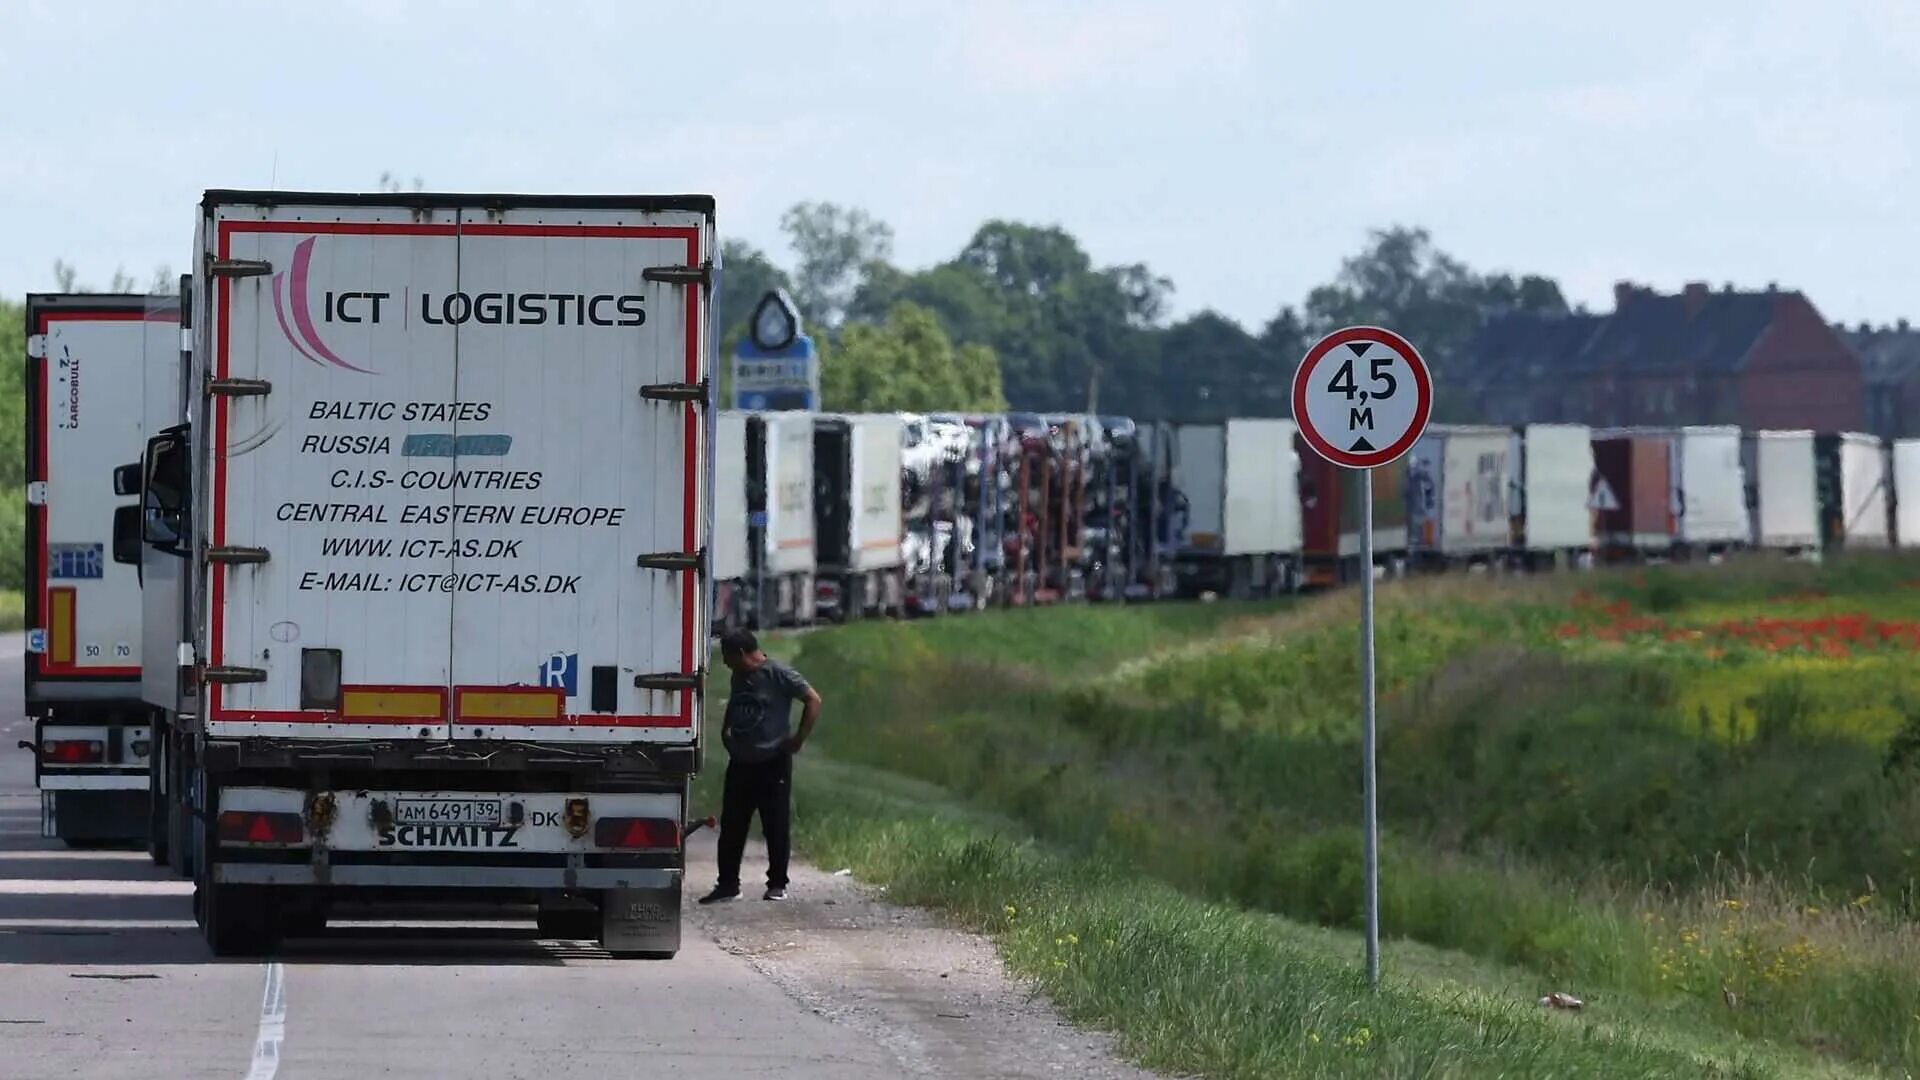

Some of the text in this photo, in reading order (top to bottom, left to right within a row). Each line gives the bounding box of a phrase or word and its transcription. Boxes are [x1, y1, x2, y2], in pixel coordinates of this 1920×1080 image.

[324, 291, 647, 327] ICT LOGISTICS
[1327, 358, 1397, 406] 4,5
[69, 359, 80, 429] CARGOBULL
[308, 401, 492, 421] BALTIC STATES
[301, 435, 390, 454] RUSSIA
[330, 470, 543, 490] C.I.S- COUNTRIES
[276, 503, 626, 527] CENTRAL EASTERN EUROPE
[321, 538, 523, 559] WWW. ICT-AS.DK
[299, 572, 583, 595] E-MAIL: ICT@ICT-AS.DK
[86, 646, 100, 657] 50
[117, 645, 130, 656] 70
[532, 812, 559, 827] DK
[378, 826, 519, 847] SCHMITZ
